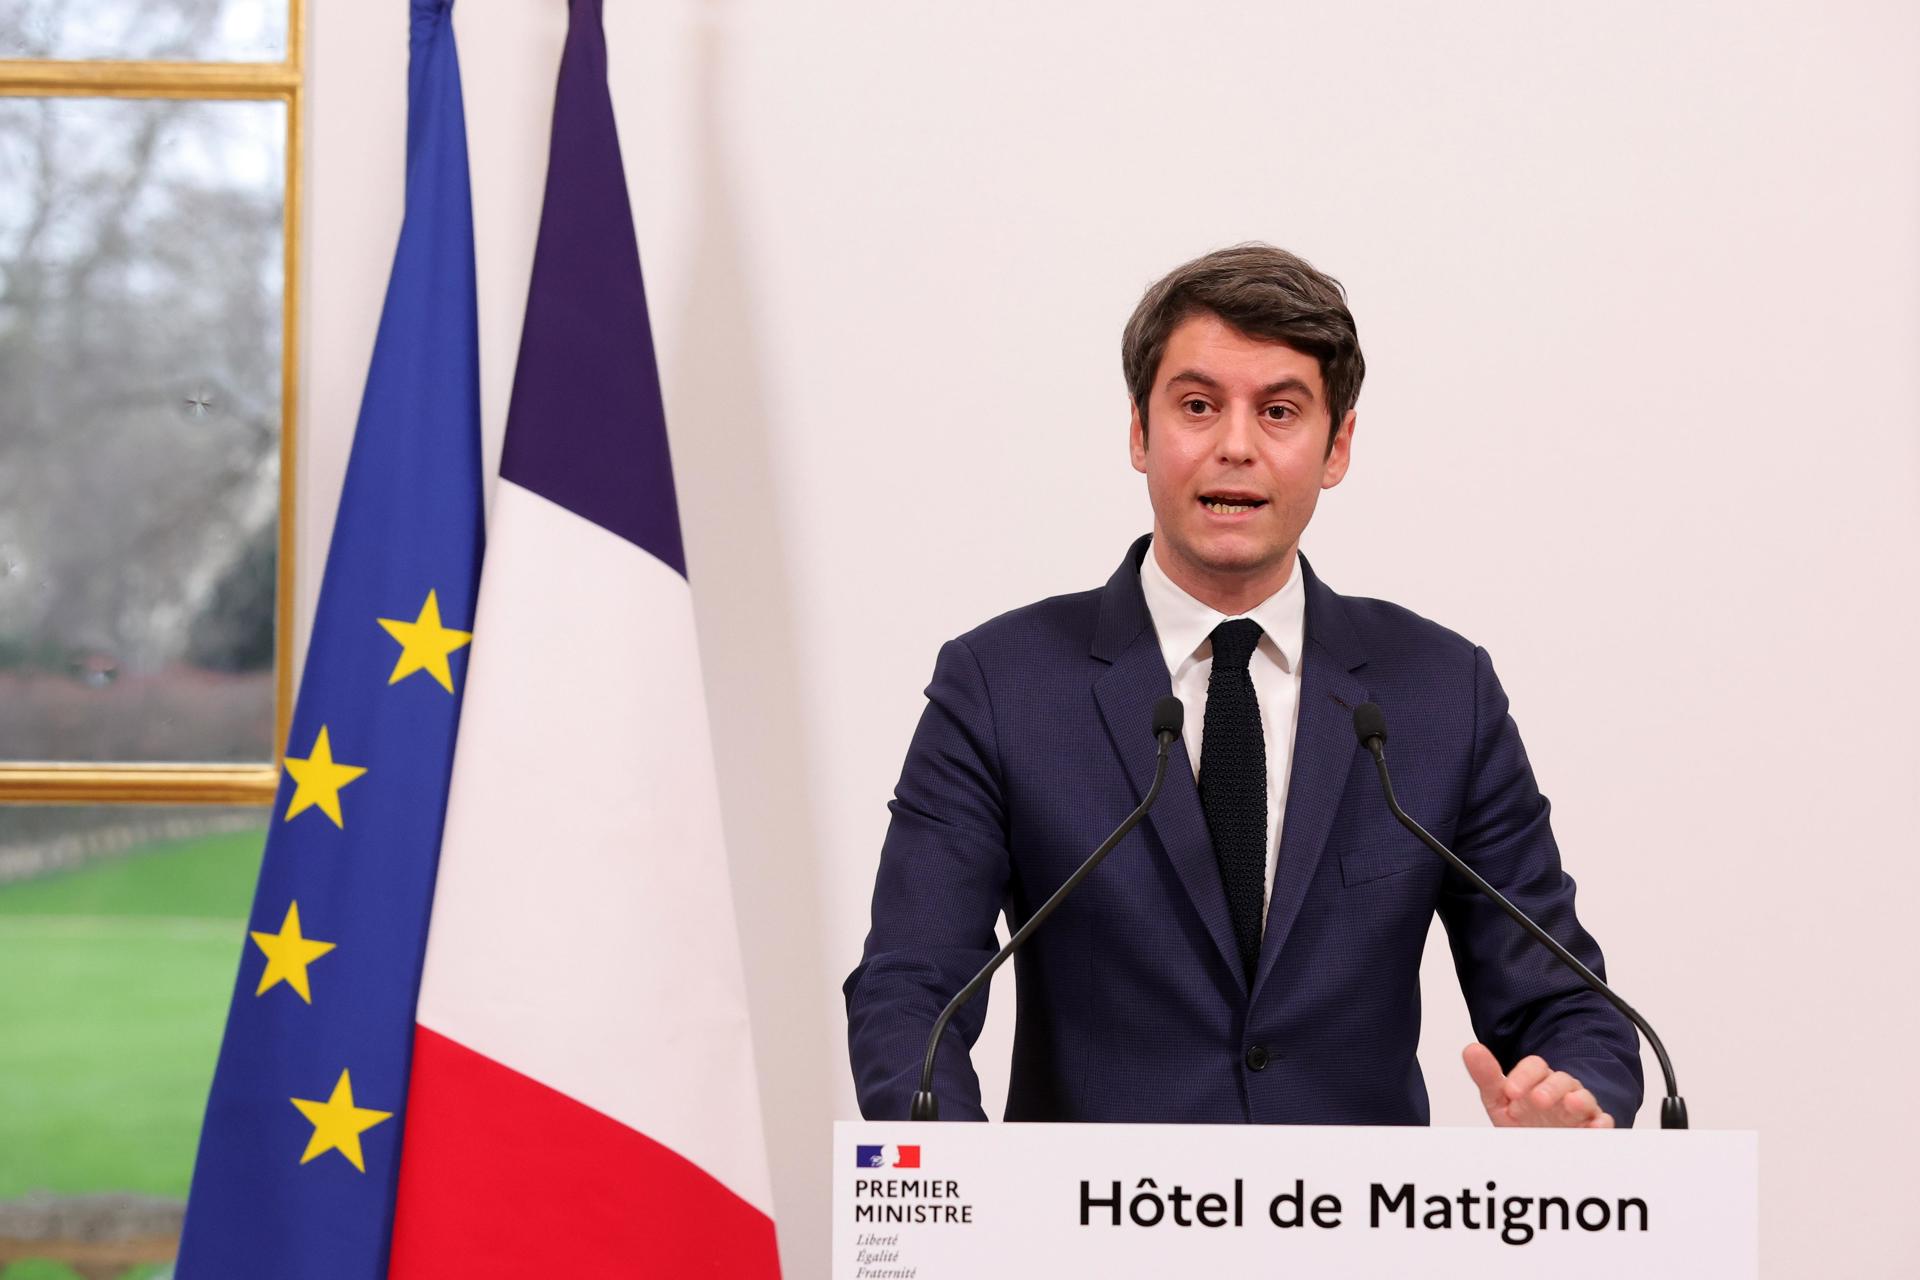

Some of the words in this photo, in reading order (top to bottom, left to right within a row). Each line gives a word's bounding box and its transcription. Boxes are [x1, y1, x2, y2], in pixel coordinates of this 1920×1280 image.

[855, 1180, 960, 1198] PREMIER
[855, 1204, 973, 1223] MINISTRE
[1080, 1178, 1244, 1228] Hôtel
[1269, 1178, 1342, 1229] de
[1369, 1180, 1650, 1246] Matignon
[856, 1233, 898, 1246] Liberté
[856, 1248, 899, 1264] Égalité
[856, 1266, 917, 1279] Fraternité
